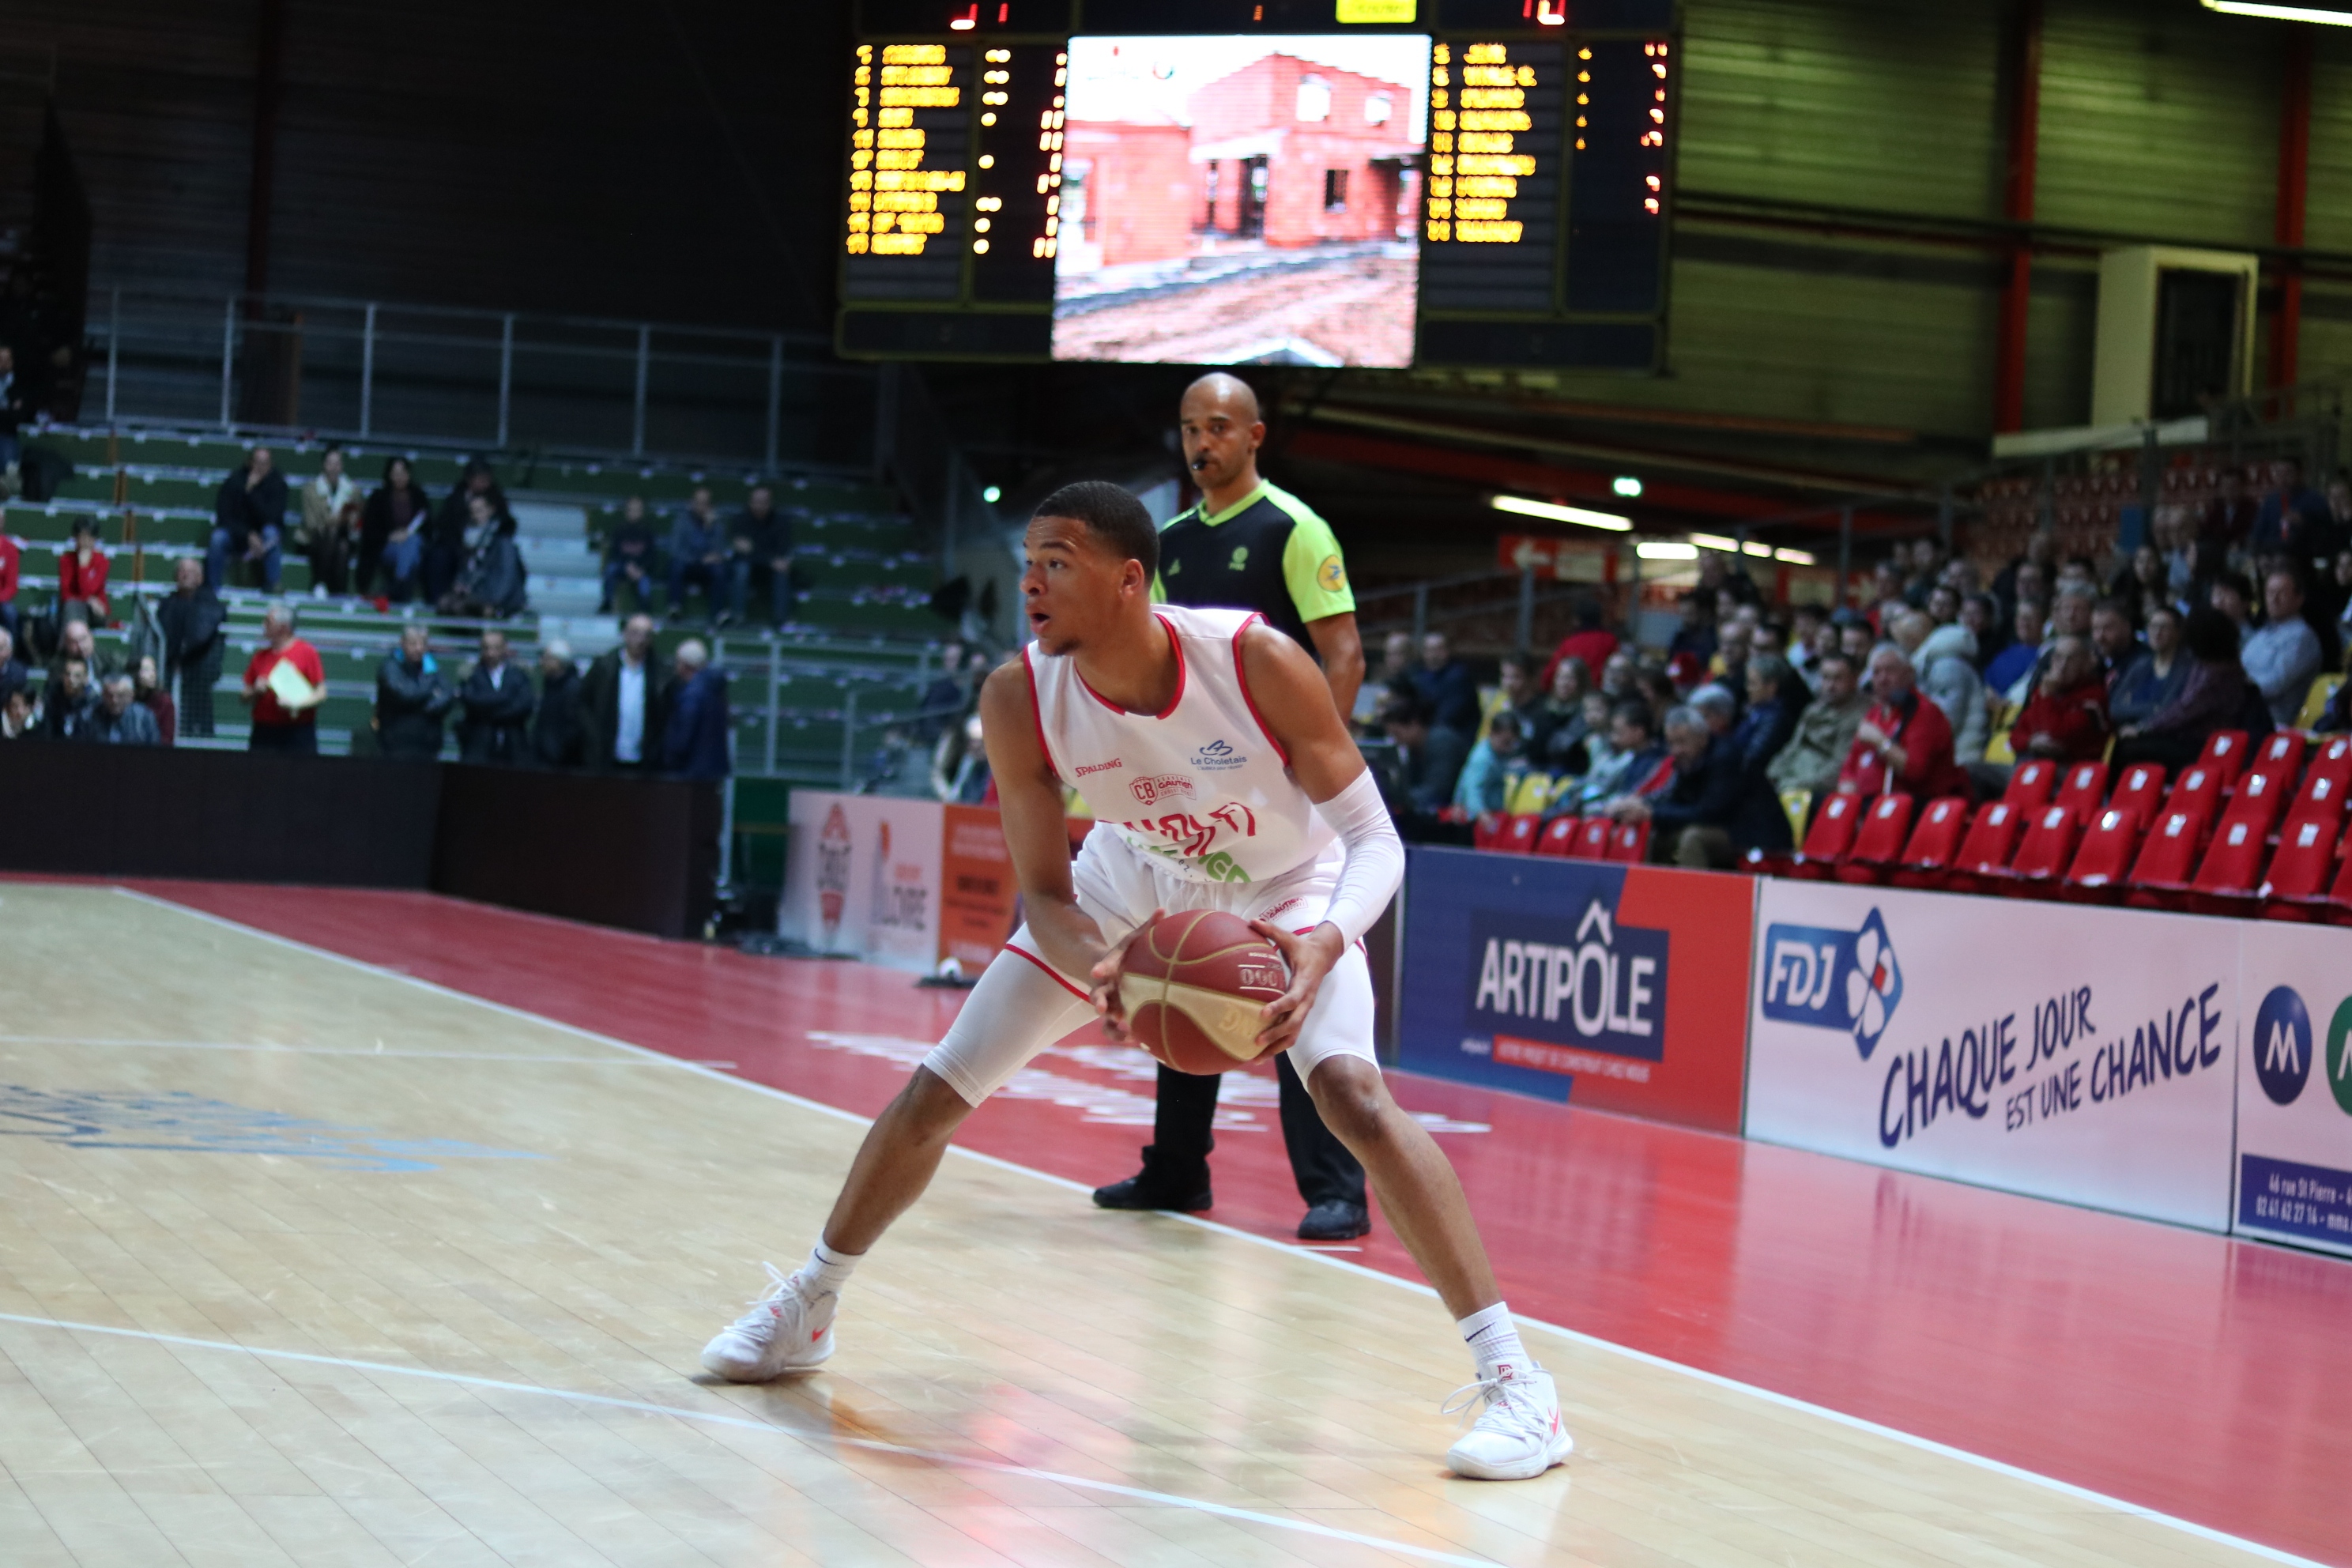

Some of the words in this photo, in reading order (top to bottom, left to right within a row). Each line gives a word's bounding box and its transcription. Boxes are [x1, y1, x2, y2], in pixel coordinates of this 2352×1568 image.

[1076, 758, 1122, 777] SPALDING
[1204, 756, 1248, 765] Choletais
[1134, 782, 1155, 800] CB
[1476, 899, 1656, 1037] ARTIPÔLE
[1767, 940, 1837, 1010] FDJ
[1880, 1013, 2016, 1148] CHAQUE
[2026, 984, 2096, 1072] JOUR
[2006, 1085, 2036, 1133] EST
[2041, 1060, 2082, 1120] UNE
[2090, 982, 2222, 1103] CHANCE
[2264, 1019, 2300, 1074] M
[2256, 1194, 2268, 1218] 02
[2281, 1200, 2293, 1223] 62
[2294, 1201, 2305, 1224] 27
[2281, 1178, 2297, 1197] rue
[2309, 1178, 2336, 1204] Pierre
